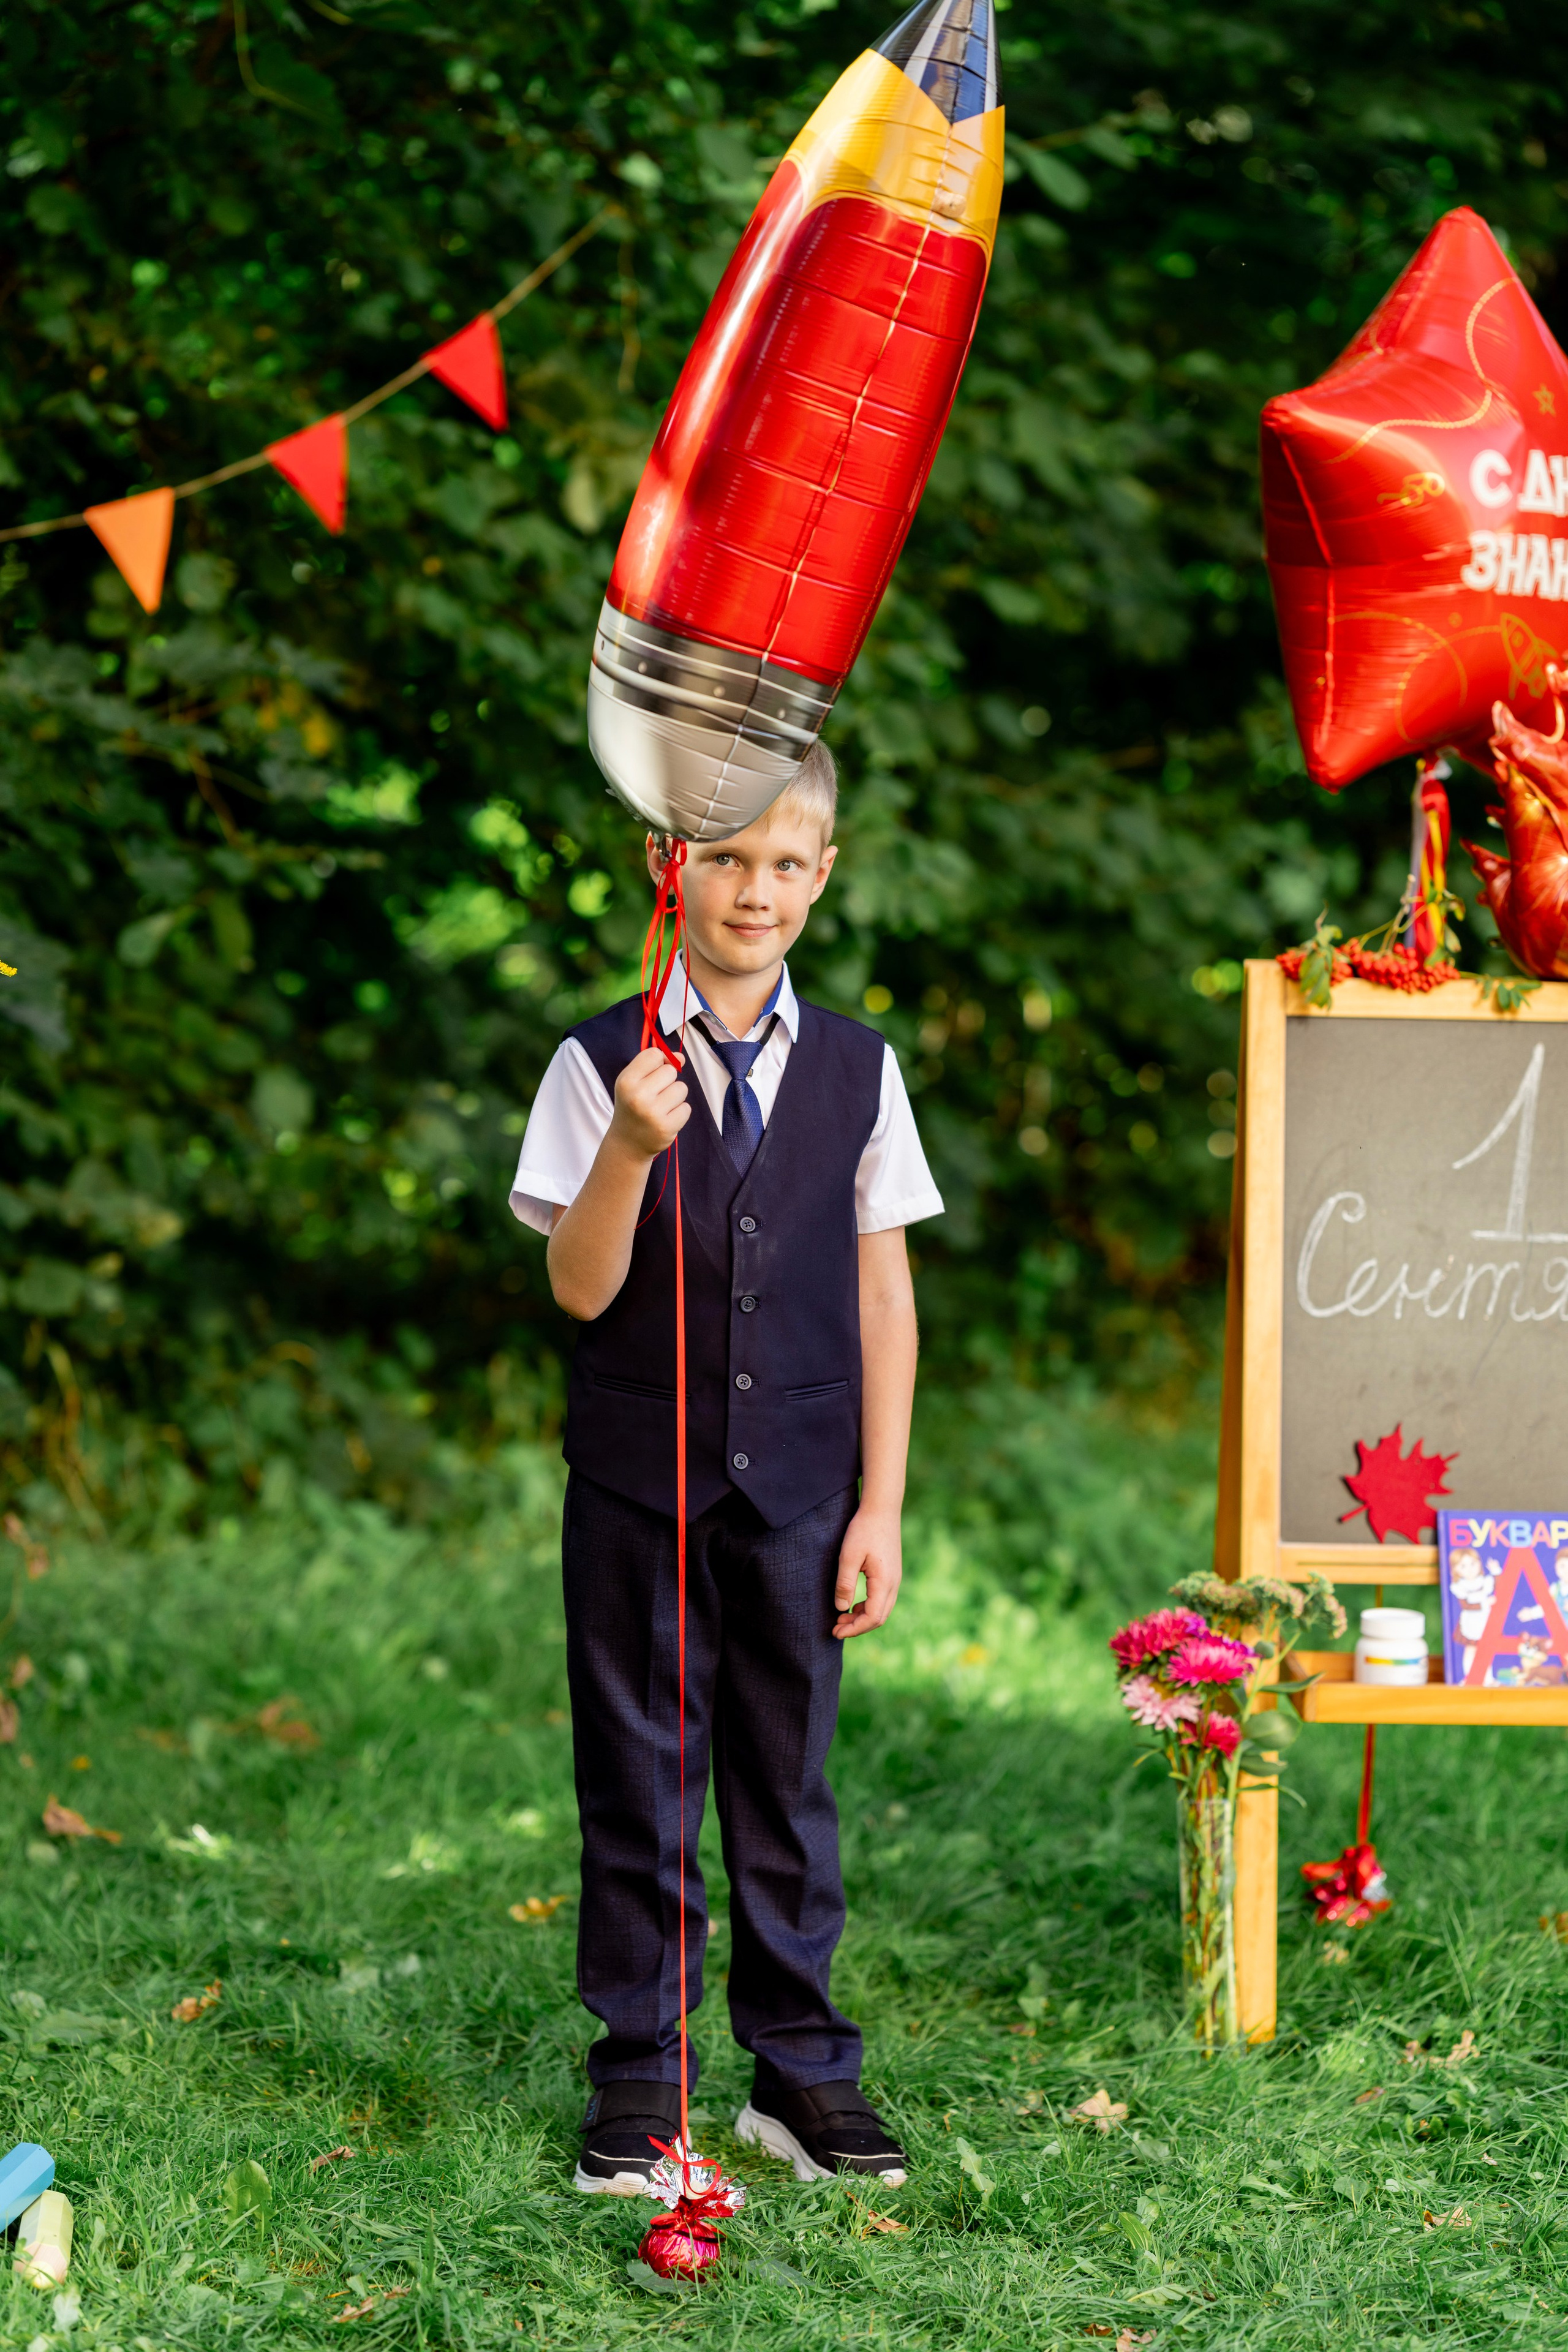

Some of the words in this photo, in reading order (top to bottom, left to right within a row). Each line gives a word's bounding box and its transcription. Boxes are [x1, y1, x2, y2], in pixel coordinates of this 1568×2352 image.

[1469, 449, 1513, 509] С
[1452, 1042, 1568, 1243] 1
[1449, 1518, 1568, 1549] БУКВАР
